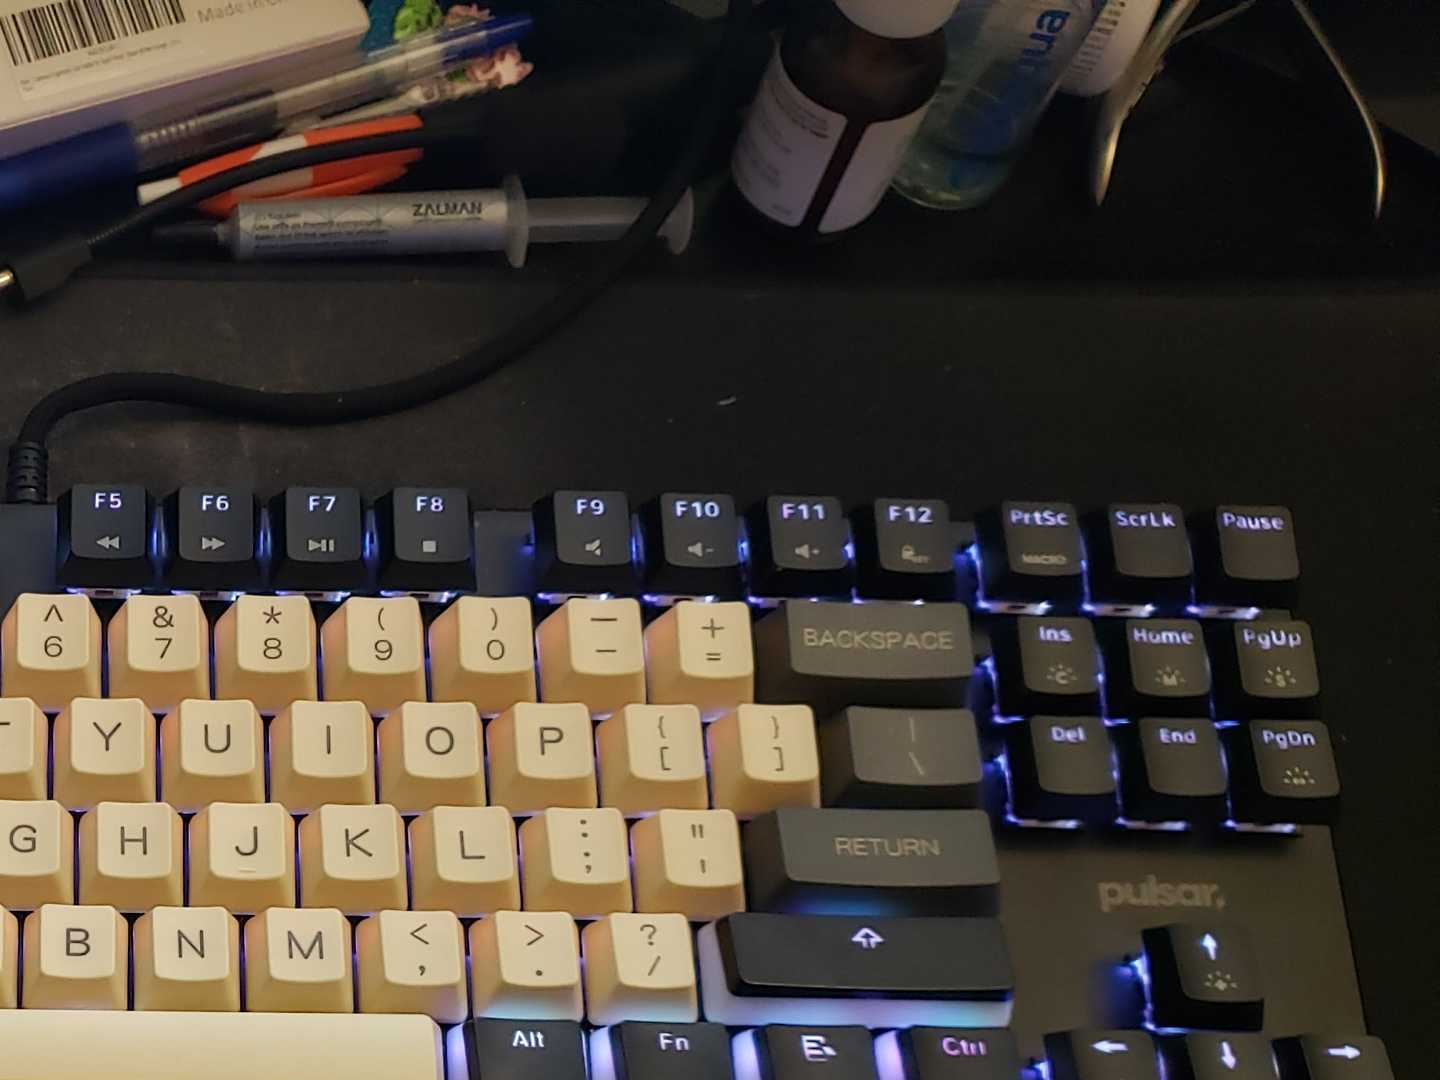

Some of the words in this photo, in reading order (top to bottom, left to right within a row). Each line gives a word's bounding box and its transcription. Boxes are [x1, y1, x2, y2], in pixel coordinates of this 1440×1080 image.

[411, 201, 483, 218] ZALMAN
[94, 492, 122, 509] F5
[202, 494, 229, 511] F6
[308, 495, 336, 512] F7
[416, 496, 444, 512] F8
[576, 498, 605, 515] F9
[675, 500, 720, 518] F10
[782, 503, 824, 520] F11
[888, 505, 932, 523] F12
[1010, 510, 1068, 526] PrtSc
[1115, 511, 1175, 527] ScrLk
[1223, 512, 1283, 530] Pause
[152, 605, 175, 629] &
[803, 627, 953, 650] BACKSPACE
[1039, 626, 1073, 642] Ins
[1133, 628, 1194, 645] Home
[1243, 629, 1301, 650] PgUp
[43, 635, 63, 658] 6
[154, 637, 173, 660] 7
[262, 637, 283, 660] 8
[374, 639, 393, 662] 9
[486, 639, 505, 661] 0
[92, 721, 122, 752] Y
[203, 723, 231, 754] U
[425, 726, 455, 756] O
[539, 726, 564, 756] P
[1051, 726, 1085, 743] Del
[1159, 728, 1196, 744] End
[1262, 730, 1316, 750] PgDn
[9, 824, 37, 854] G
[120, 825, 148, 856] H
[234, 825, 259, 857] J
[344, 828, 373, 858] K
[458, 830, 486, 860] L
[835, 837, 940, 857] RETURN
[65, 927, 91, 957] B
[177, 929, 205, 959] N
[287, 930, 324, 960] M
[512, 1030, 545, 1048] Alt
[659, 1032, 689, 1051] Fn
[942, 1037, 986, 1056] Ctrl
